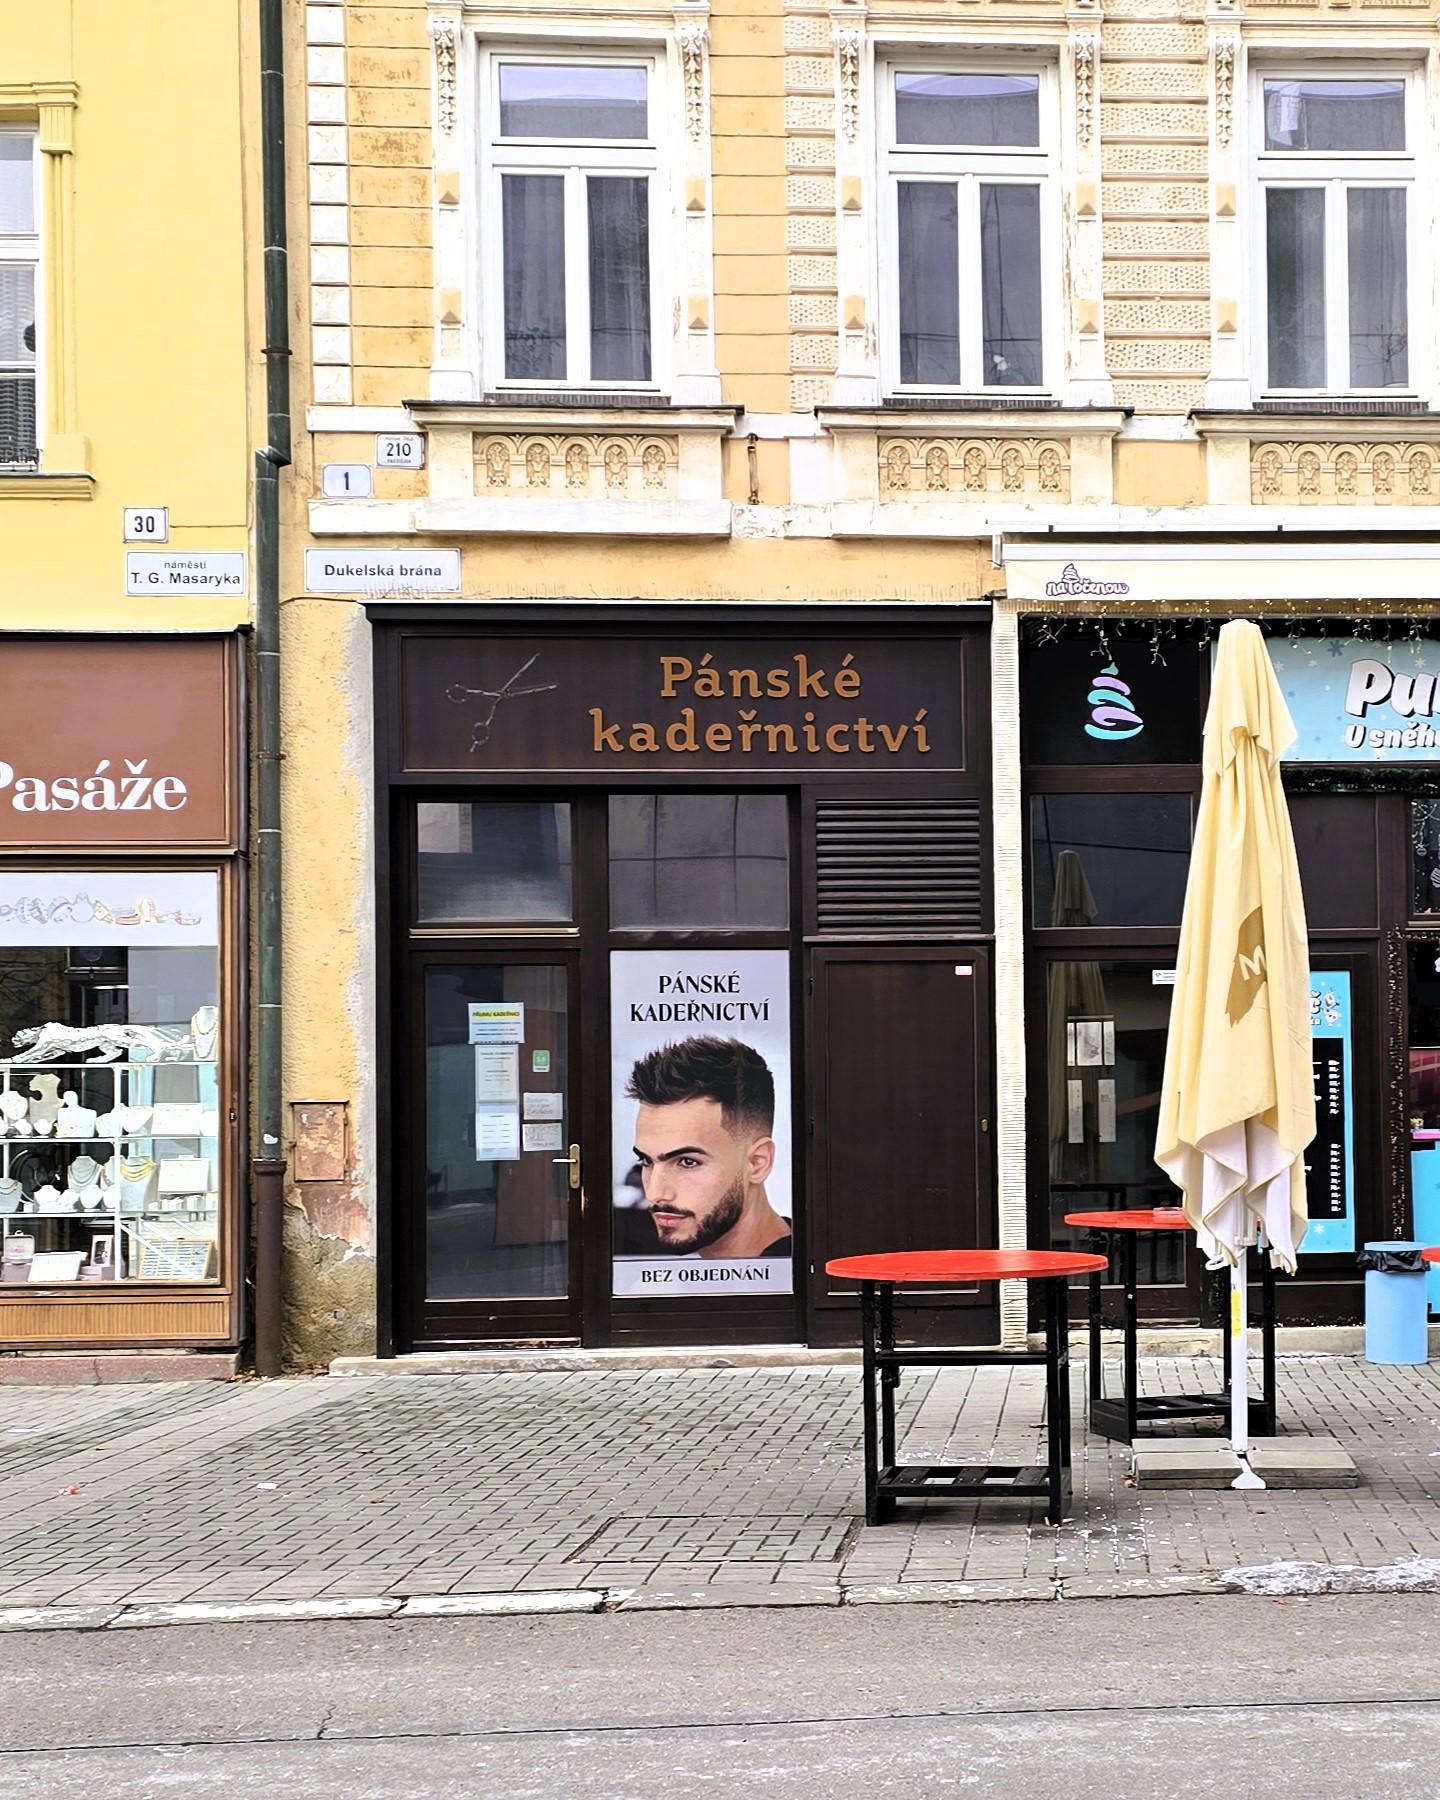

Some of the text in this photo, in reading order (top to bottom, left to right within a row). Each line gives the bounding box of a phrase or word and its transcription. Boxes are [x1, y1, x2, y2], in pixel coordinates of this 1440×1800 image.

[386, 443, 411, 457] 210
[344, 471, 350, 491] 1
[134, 515, 155, 533] 30
[131, 572, 241, 587] T. G. Masaryka
[324, 564, 442, 576] Dukelská brána
[660, 652, 861, 697] Pánské
[1344, 658, 1440, 718] Pu
[588, 707, 931, 752] kadeřnictví
[1344, 721, 1440, 748] U sněh
[659, 970, 741, 994] PÁNSKÉ
[630, 998, 770, 1022] KADEŘNICTVÍ
[642, 1265, 770, 1283] BEZ OBJEDNÁNÍ
